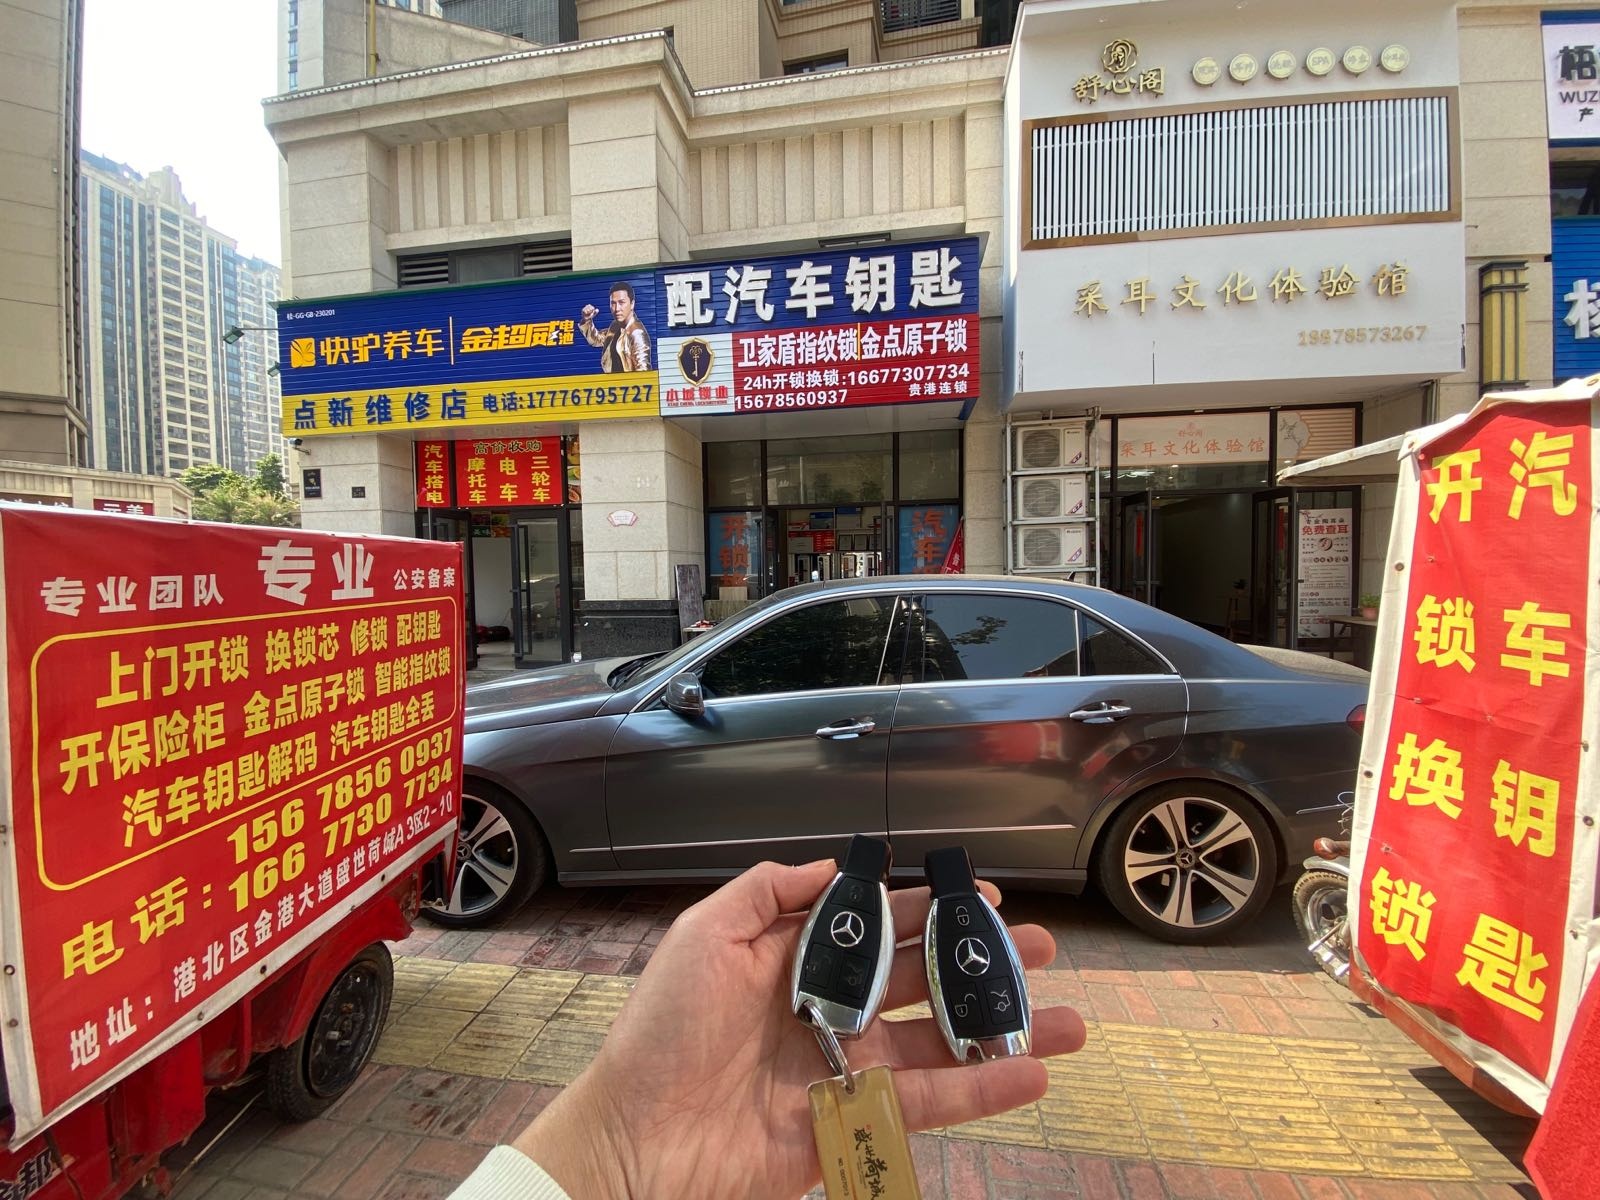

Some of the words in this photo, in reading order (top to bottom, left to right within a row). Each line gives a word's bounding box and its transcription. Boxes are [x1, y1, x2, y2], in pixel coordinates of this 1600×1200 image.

[1073, 66, 1165, 101] 舒心阁
[1560, 91, 1600, 103] WUZ
[664, 247, 964, 327] 配汽车钥匙
[1075, 263, 1410, 316] 采耳文化体验馆
[320, 328, 444, 366] 快驴养车
[738, 328, 858, 368] 卫家盾指纹锁
[860, 319, 967, 360] 金点原子锁
[294, 389, 467, 429] 点新维修店
[734, 390, 848, 409] 15678560937
[908, 380, 967, 397] 贵港连锁
[473, 440, 542, 455] 高价收购
[1120, 437, 1265, 457] 采耳文化体验馆
[424, 444, 444, 504] 汽车搭电
[467, 457, 487, 504] 摩托车
[499, 457, 518, 503] 电车
[531, 455, 551, 503] 三轮车
[40, 574, 224, 616] 专业团队
[258, 540, 374, 606] 专业
[393, 567, 455, 591] 公安备案
[96, 635, 249, 708] 上门开锁
[265, 624, 340, 673] 换锁芯
[350, 616, 388, 657] 修锁
[396, 610, 441, 647] 配钥匙
[60, 702, 225, 795] 开保险柜
[243, 669, 365, 739] 金点原子锁
[375, 647, 450, 698] 智能指纹锁
[1369, 448, 1482, 961] 开锁换锁
[1456, 431, 1578, 1022] 汽车钥匙
[122, 732, 318, 847] 汽车钥匙解码
[330, 691, 435, 763] 汽车钥匙全丢
[227, 800, 304, 864] 156
[316, 757, 391, 820] 7856
[399, 727, 453, 776] 0937
[228, 843, 306, 913] 166
[322, 793, 392, 858] 7730
[404, 758, 453, 807] 7734
